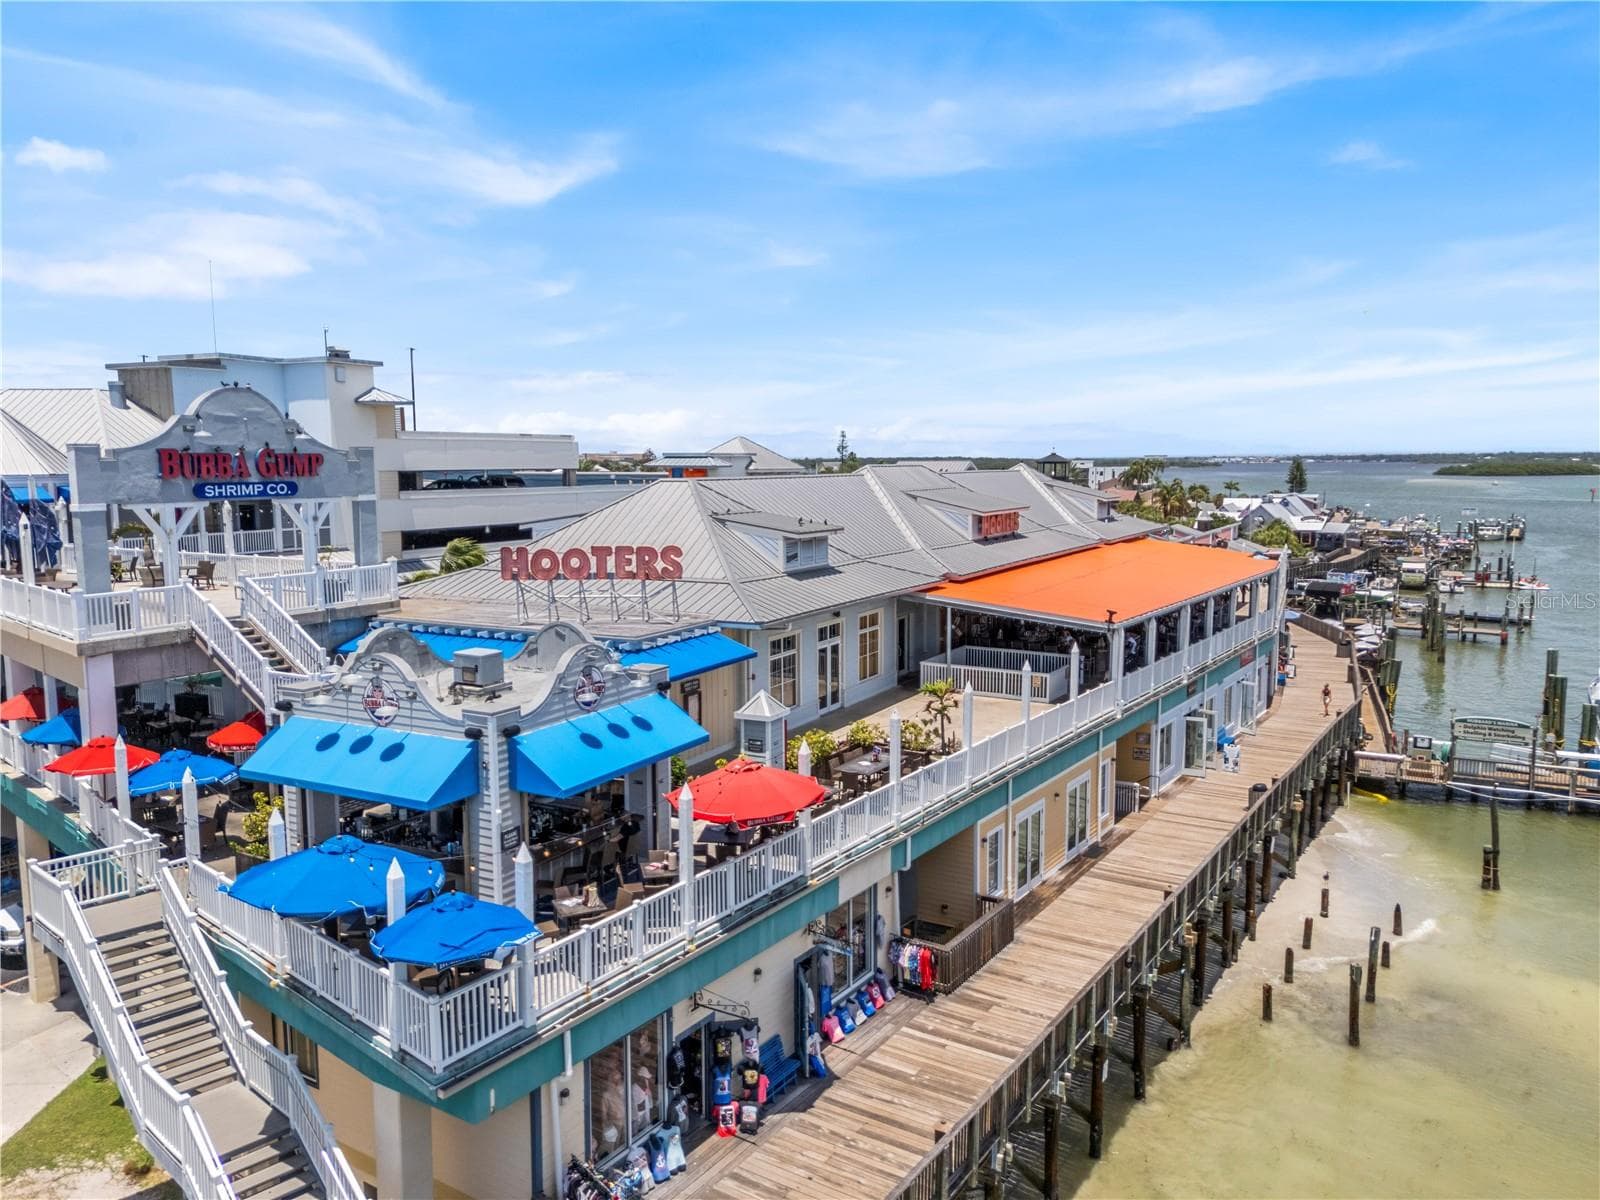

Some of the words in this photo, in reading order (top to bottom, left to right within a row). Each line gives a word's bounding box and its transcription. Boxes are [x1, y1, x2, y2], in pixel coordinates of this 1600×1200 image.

[158, 448, 250, 479] BUBBA
[256, 448, 324, 479] GUMP
[204, 484, 264, 497] SHRIMP
[266, 483, 291, 495] CO.
[500, 545, 683, 581] HOOTERS
[1488, 726, 1515, 734] Watching
